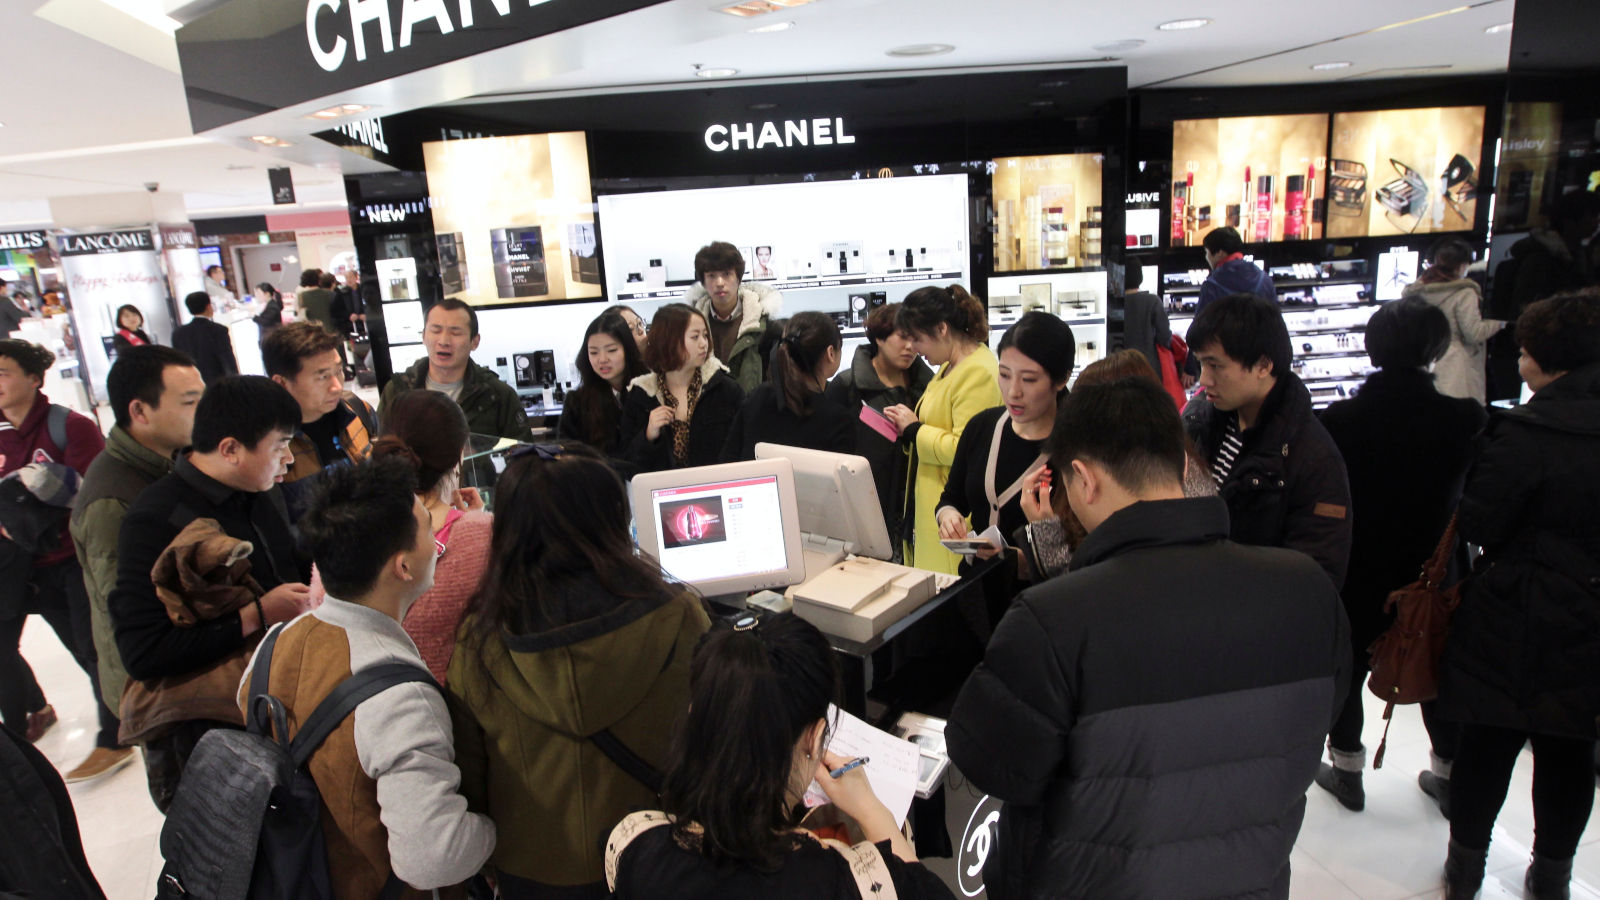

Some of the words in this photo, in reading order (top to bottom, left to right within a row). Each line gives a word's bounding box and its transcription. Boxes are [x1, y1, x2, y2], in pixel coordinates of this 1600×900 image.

[306, 0, 550, 72] CHA
[333, 116, 389, 154] ANEL
[704, 117, 856, 152] CHANEL
[1125, 192, 1160, 203] USIVE
[369, 208, 406, 223] NEW
